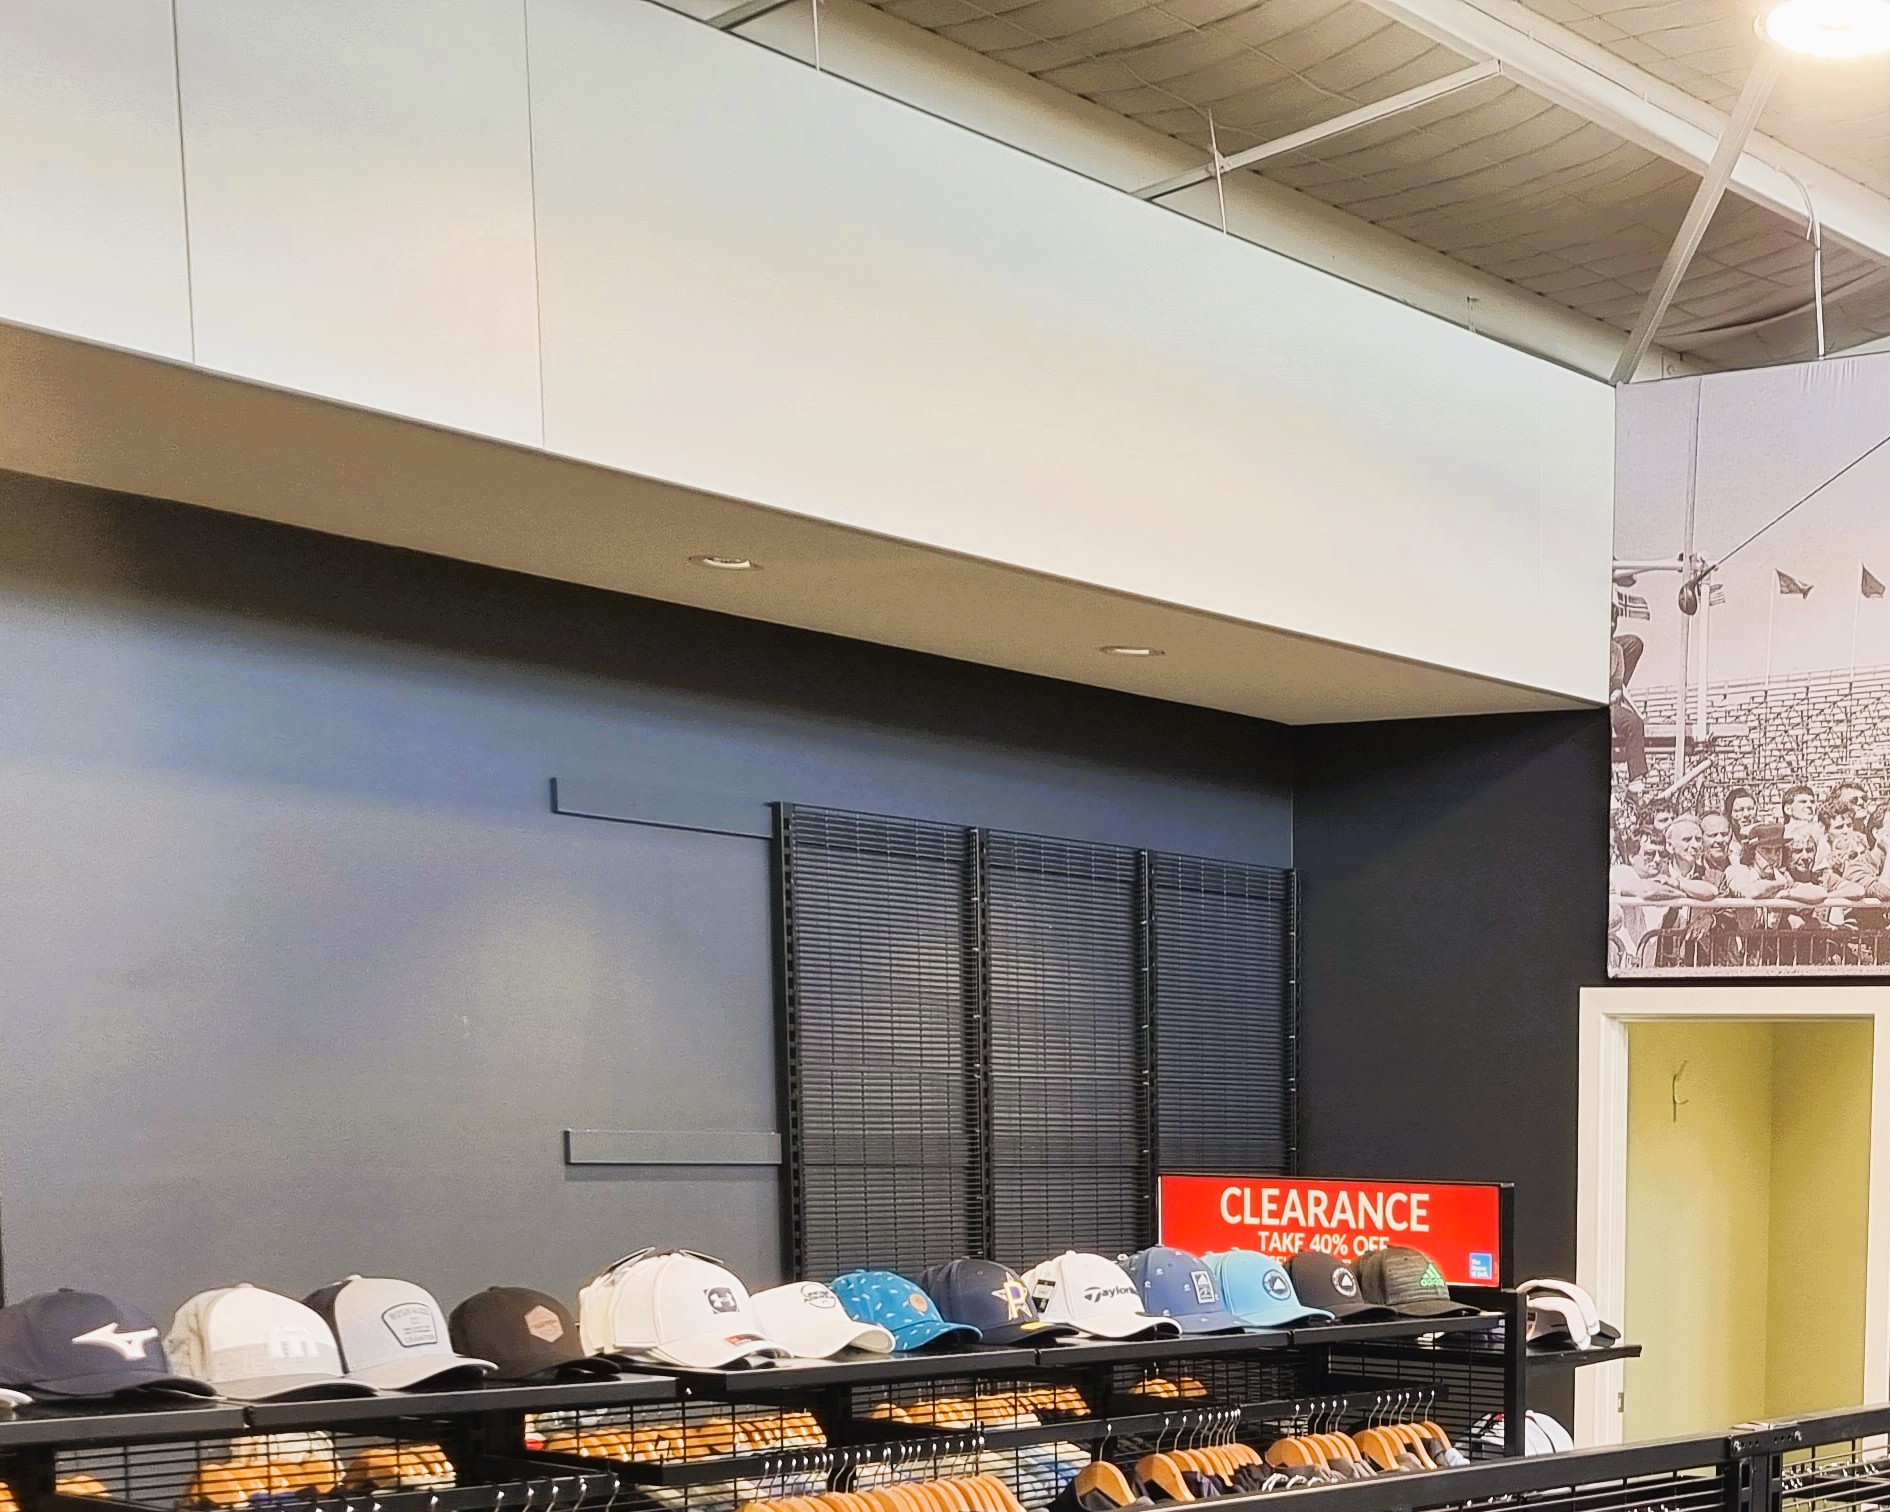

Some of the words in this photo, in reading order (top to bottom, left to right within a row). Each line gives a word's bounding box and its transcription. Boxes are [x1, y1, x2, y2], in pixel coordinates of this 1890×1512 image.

[1219, 1186, 1431, 1233] CLEARANCE
[1257, 1230, 1306, 1254] TAKE
[1309, 1232, 1349, 1256] 40%
[1352, 1235, 1390, 1256] OFF
